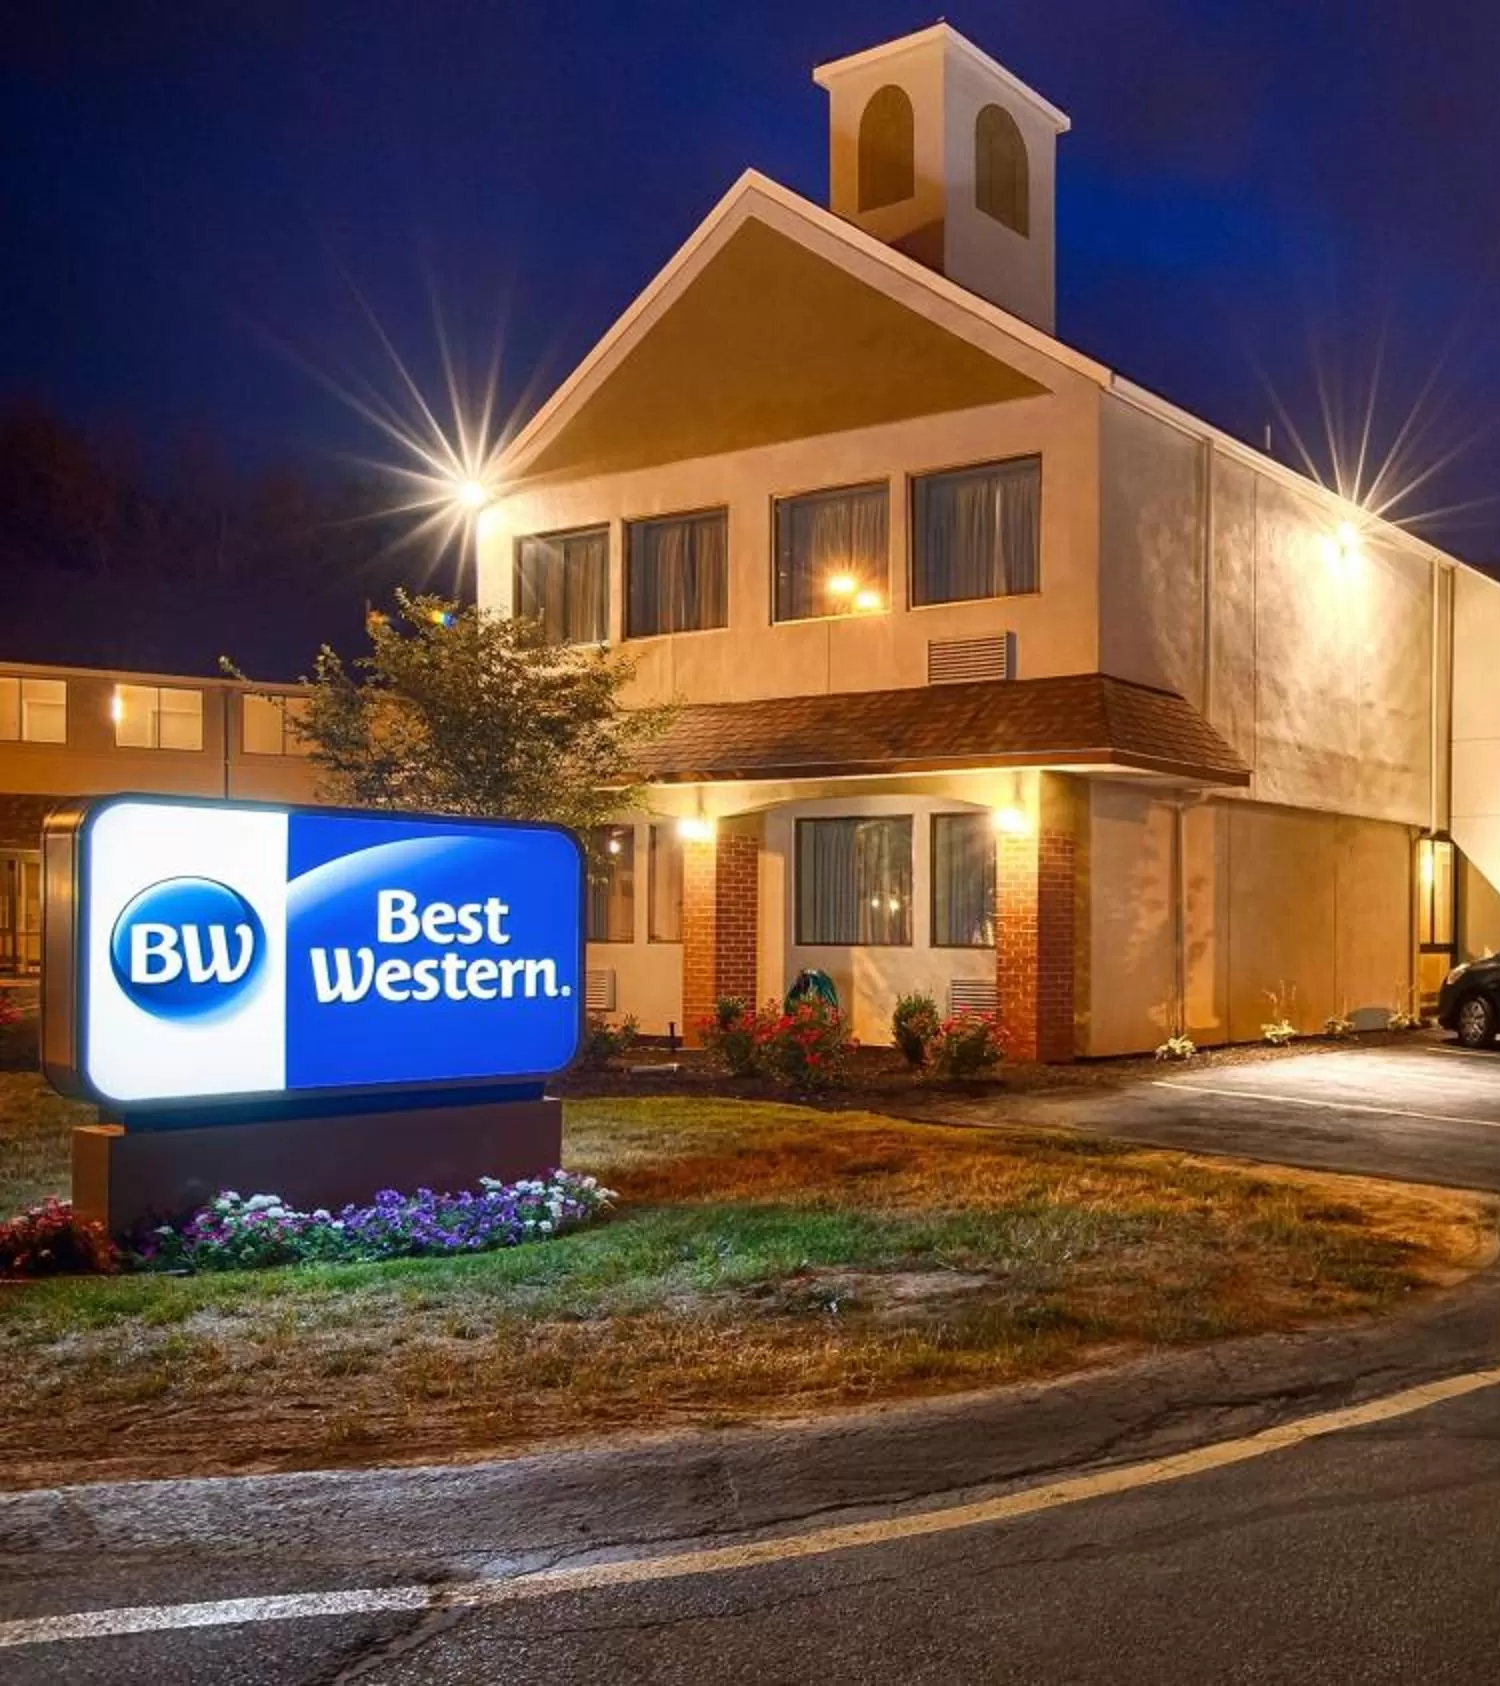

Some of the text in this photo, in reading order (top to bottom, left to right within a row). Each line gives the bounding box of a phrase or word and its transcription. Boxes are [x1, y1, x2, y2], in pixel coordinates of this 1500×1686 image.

[377, 889, 510, 945] Best
[129, 922, 254, 984] BW
[310, 945, 571, 1003] Western.
